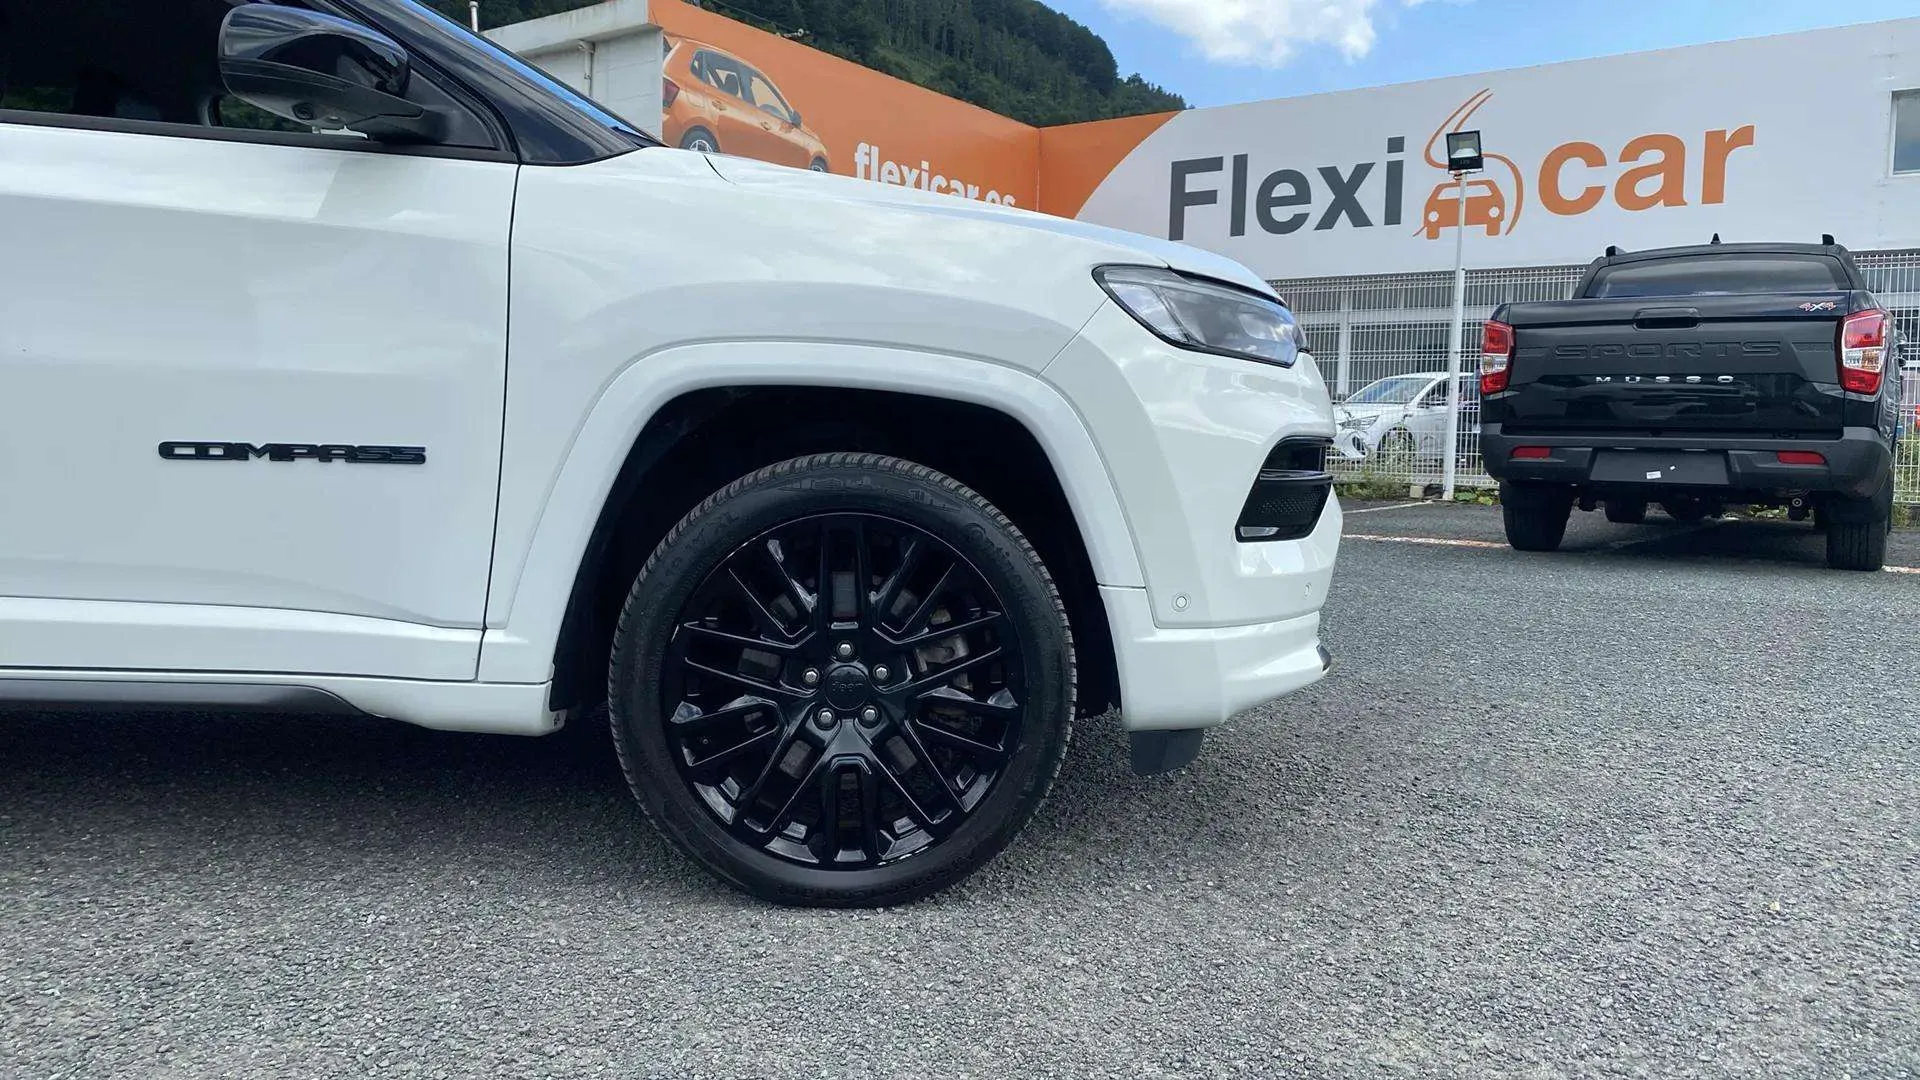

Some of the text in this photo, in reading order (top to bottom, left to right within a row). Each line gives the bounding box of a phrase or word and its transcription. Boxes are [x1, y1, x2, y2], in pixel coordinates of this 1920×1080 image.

[854, 142, 1016, 207] flexicares
[1168, 124, 1755, 241] Flexi car
[1552, 340, 1781, 360] SPORTS
[1595, 375, 1734, 384] MUSSO
[158, 441, 427, 465] COMPASS
